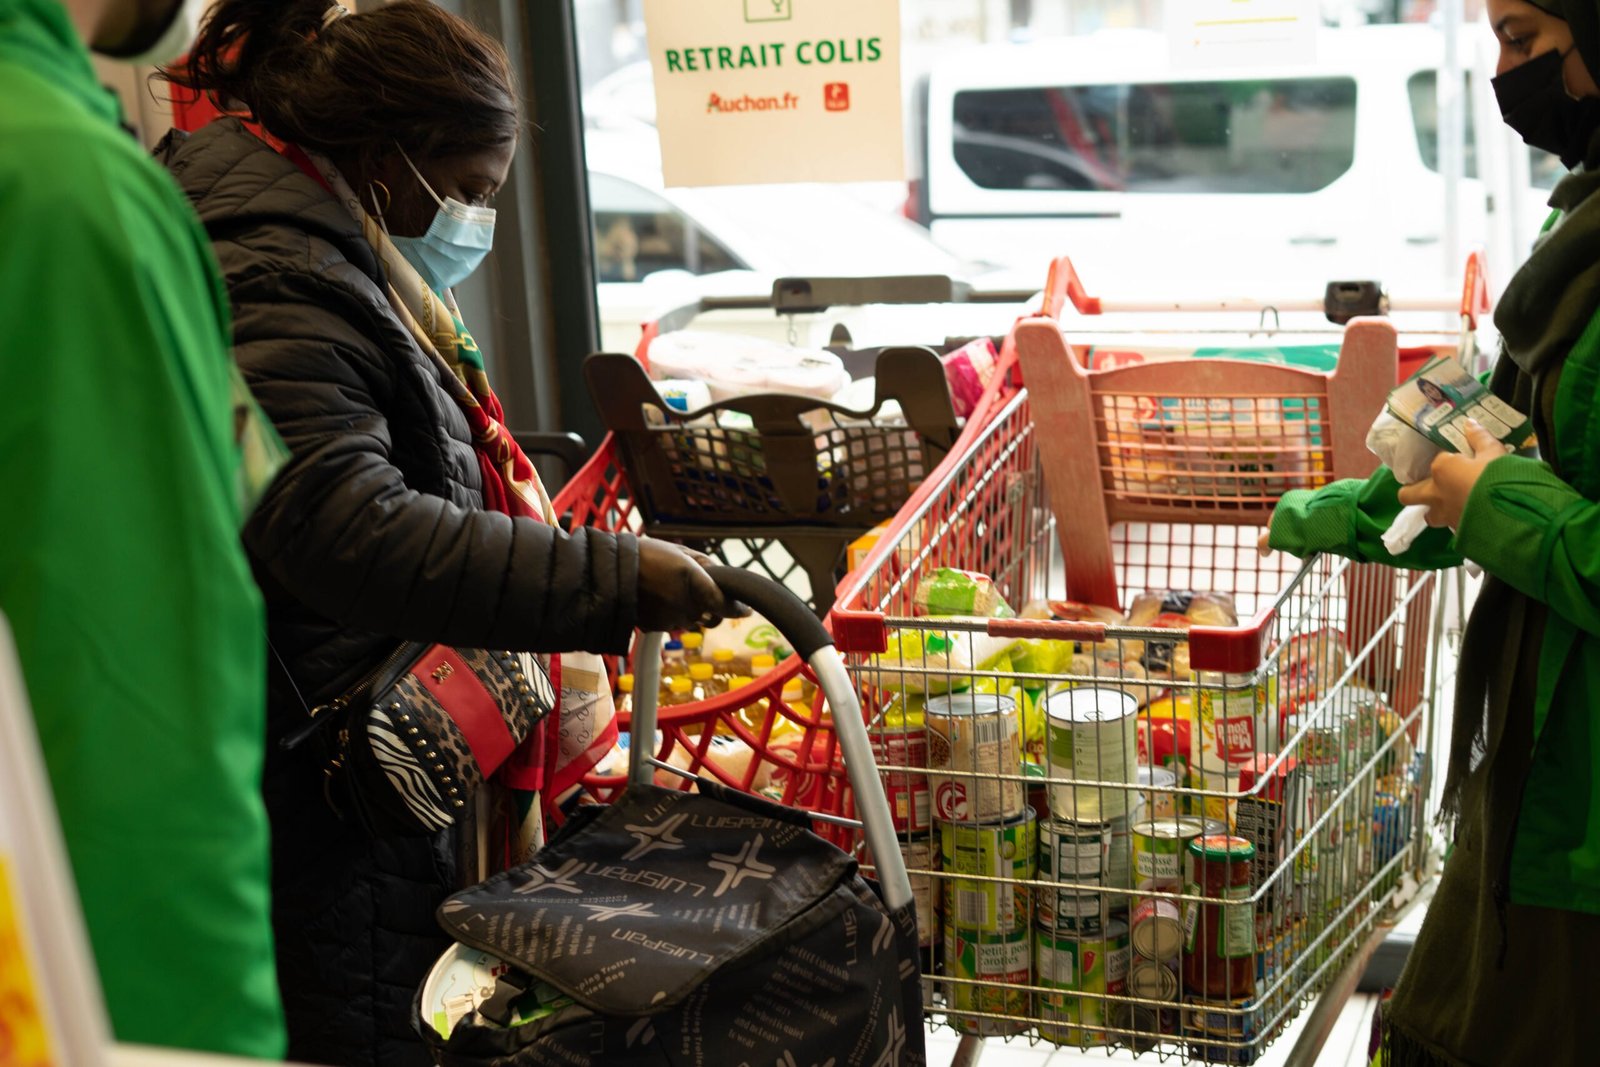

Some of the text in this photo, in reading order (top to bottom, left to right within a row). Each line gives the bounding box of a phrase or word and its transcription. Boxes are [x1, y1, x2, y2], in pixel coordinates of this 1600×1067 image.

[665, 38, 882, 73] RETRAIT COLIS
[706, 92, 799, 113] Auchan.fr
